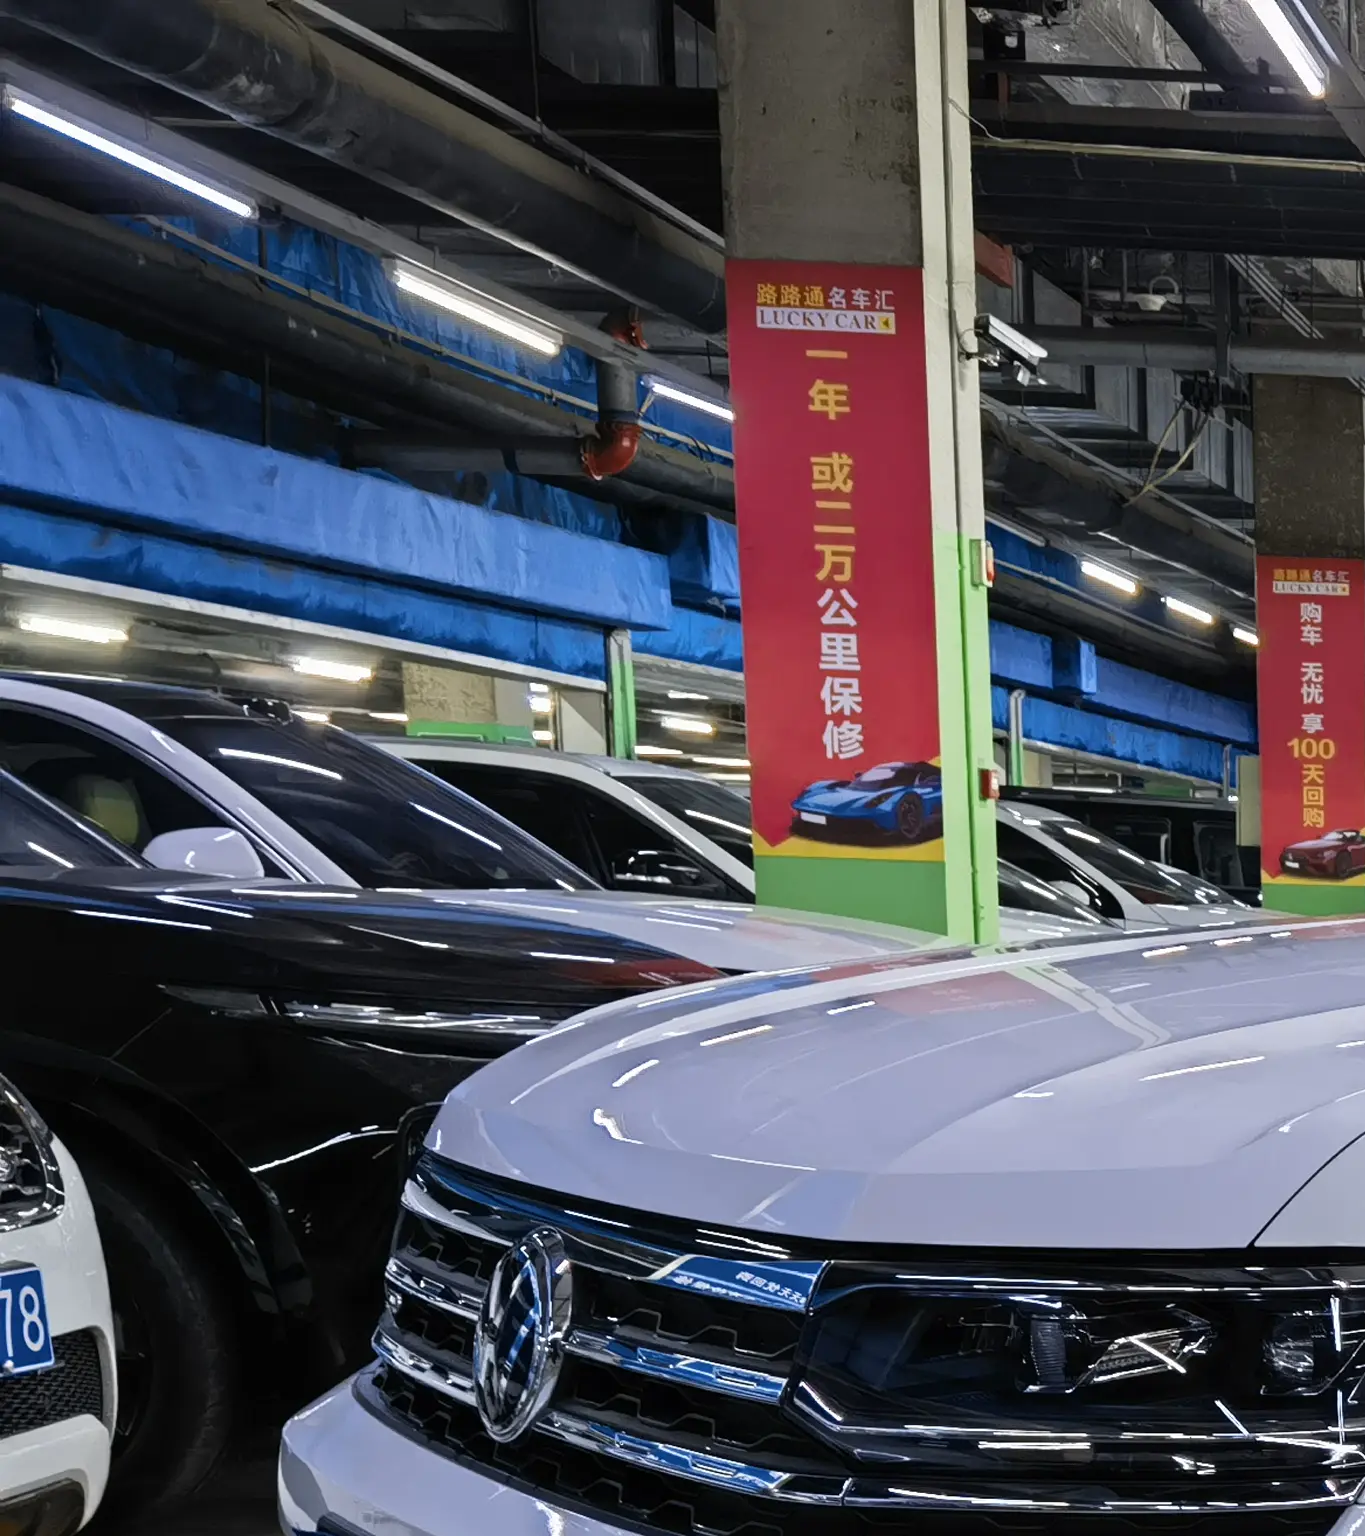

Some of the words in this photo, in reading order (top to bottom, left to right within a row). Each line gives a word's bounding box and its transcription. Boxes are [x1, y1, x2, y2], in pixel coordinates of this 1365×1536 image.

[756, 283, 896, 311] 路路通名车汇
[759, 309, 829, 328] LUCKY
[835, 313, 876, 330] CAR
[1275, 582, 1312, 593] LUCKY
